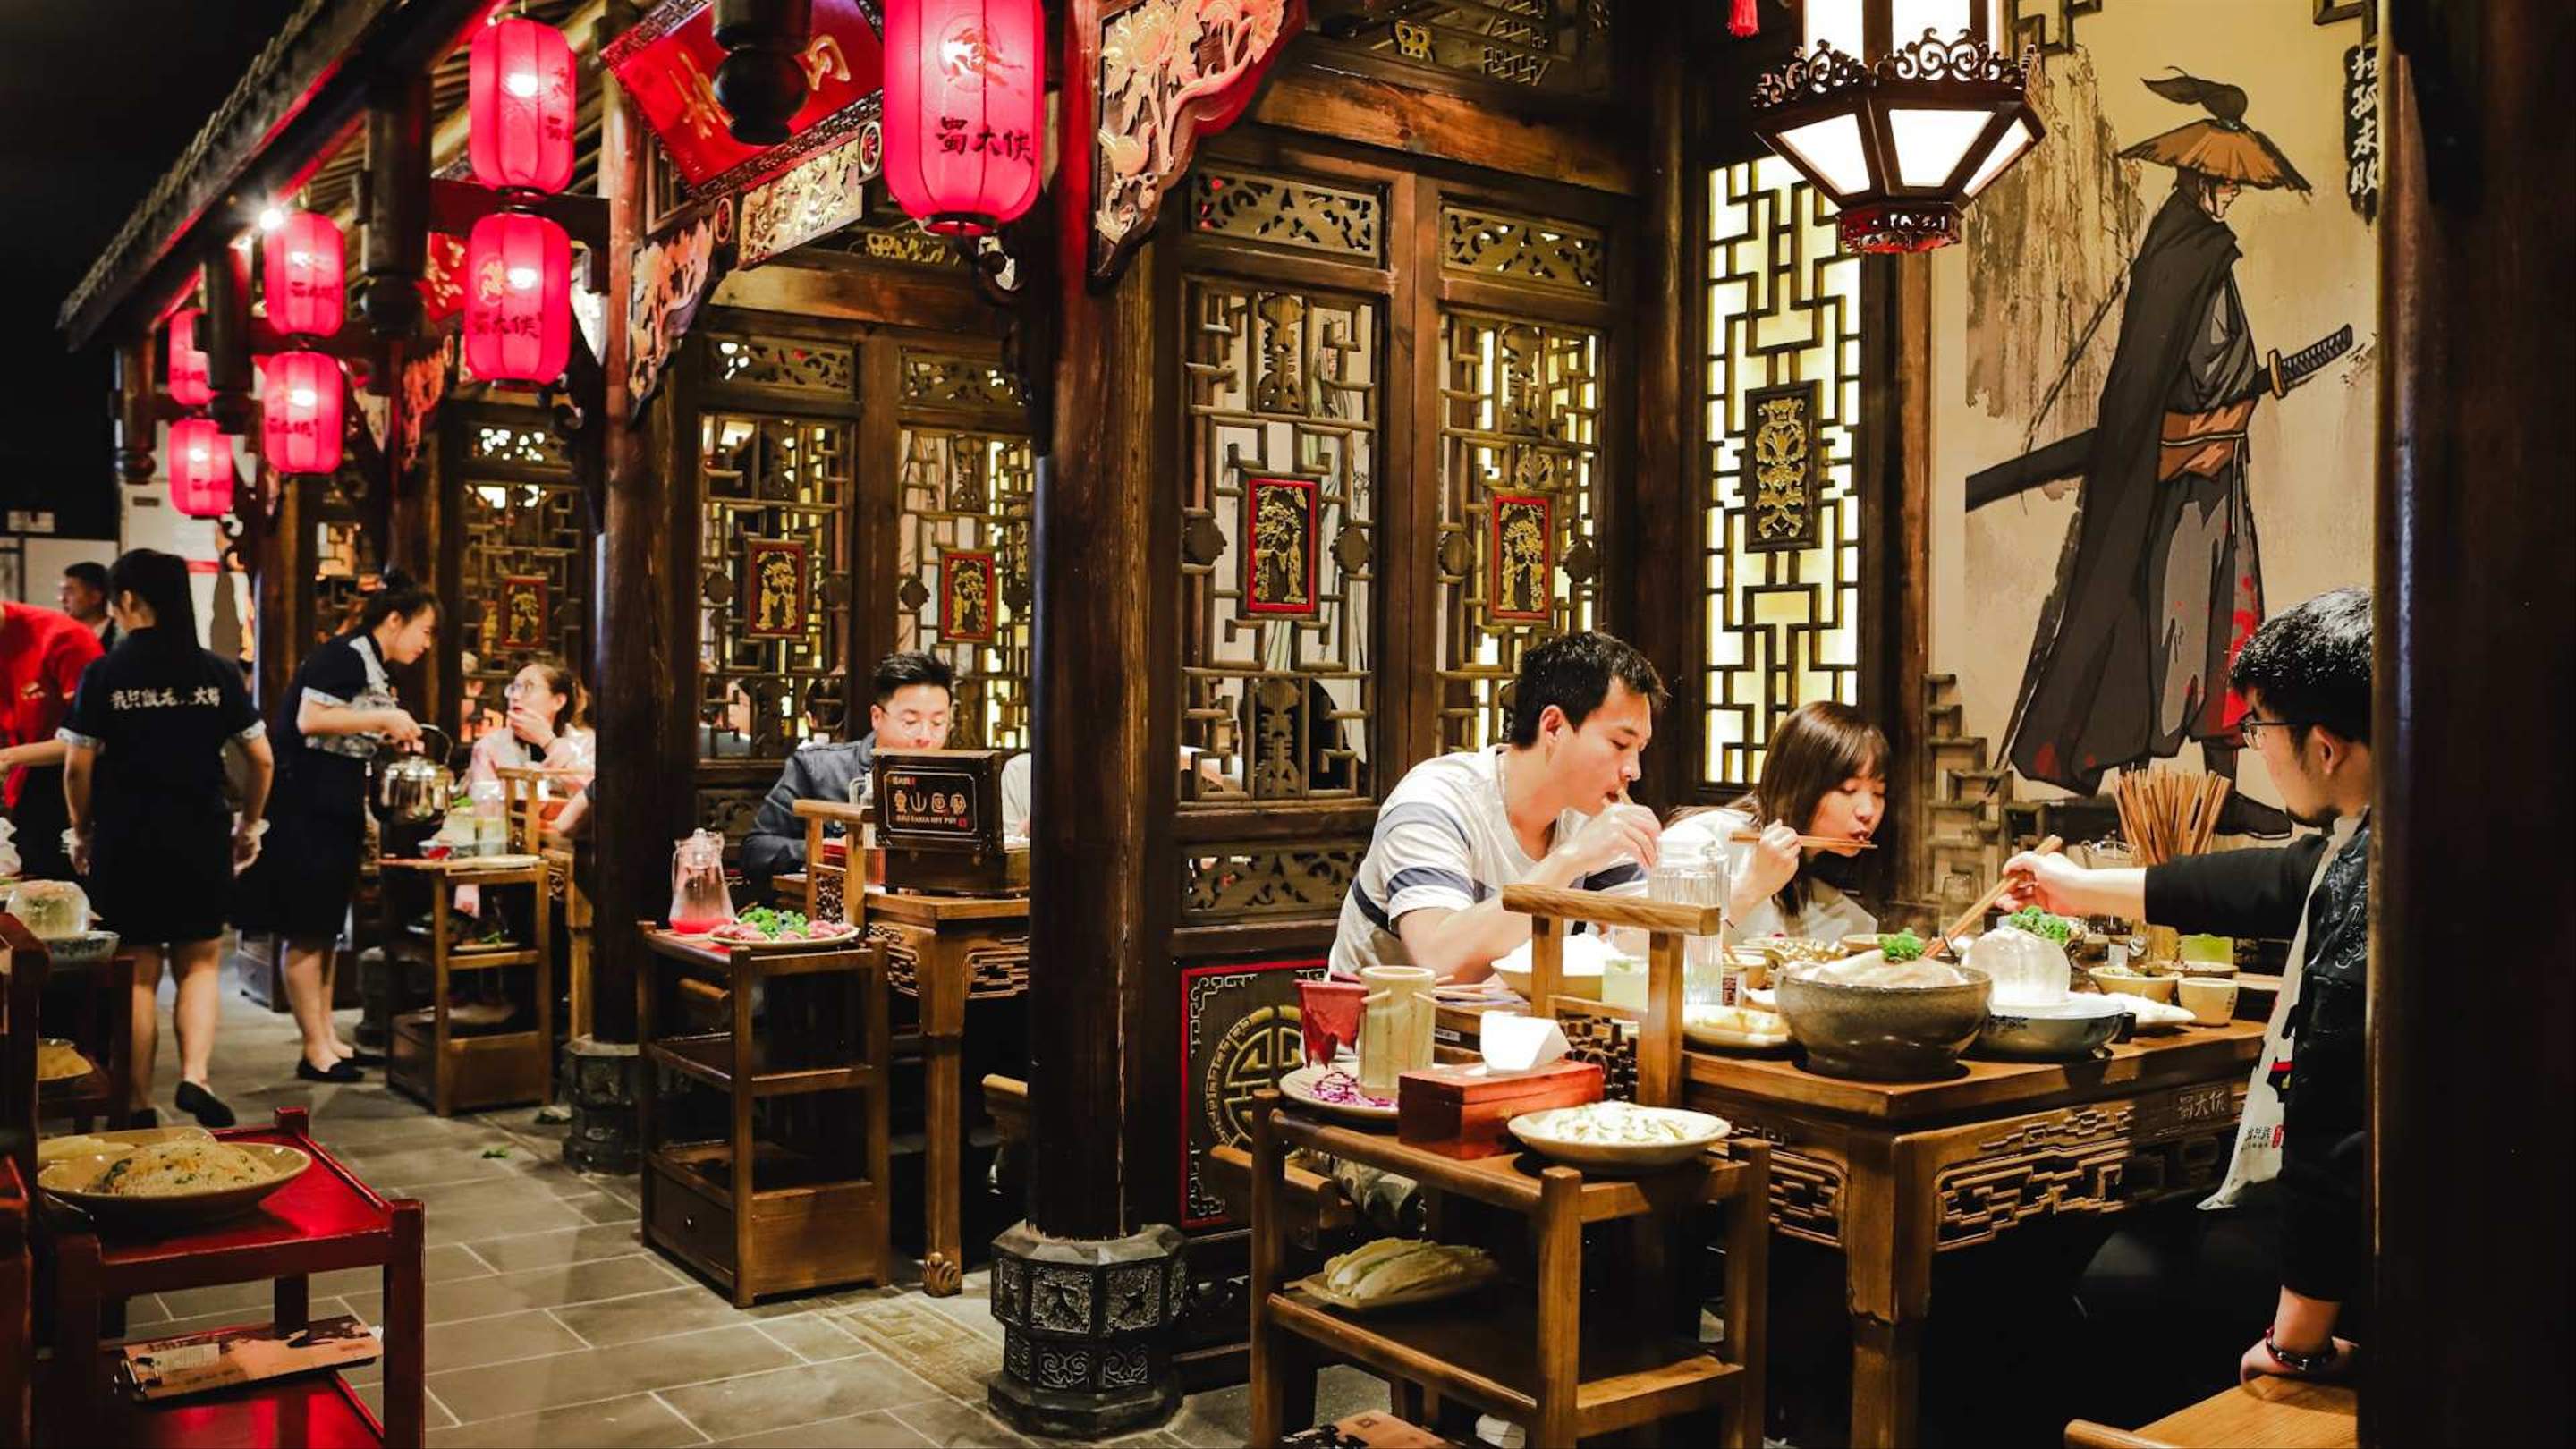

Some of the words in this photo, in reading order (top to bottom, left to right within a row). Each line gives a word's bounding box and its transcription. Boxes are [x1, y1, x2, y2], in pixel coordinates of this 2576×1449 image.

[935, 115, 1035, 167] 蜀大侠
[473, 311, 540, 339] 蜀大侠
